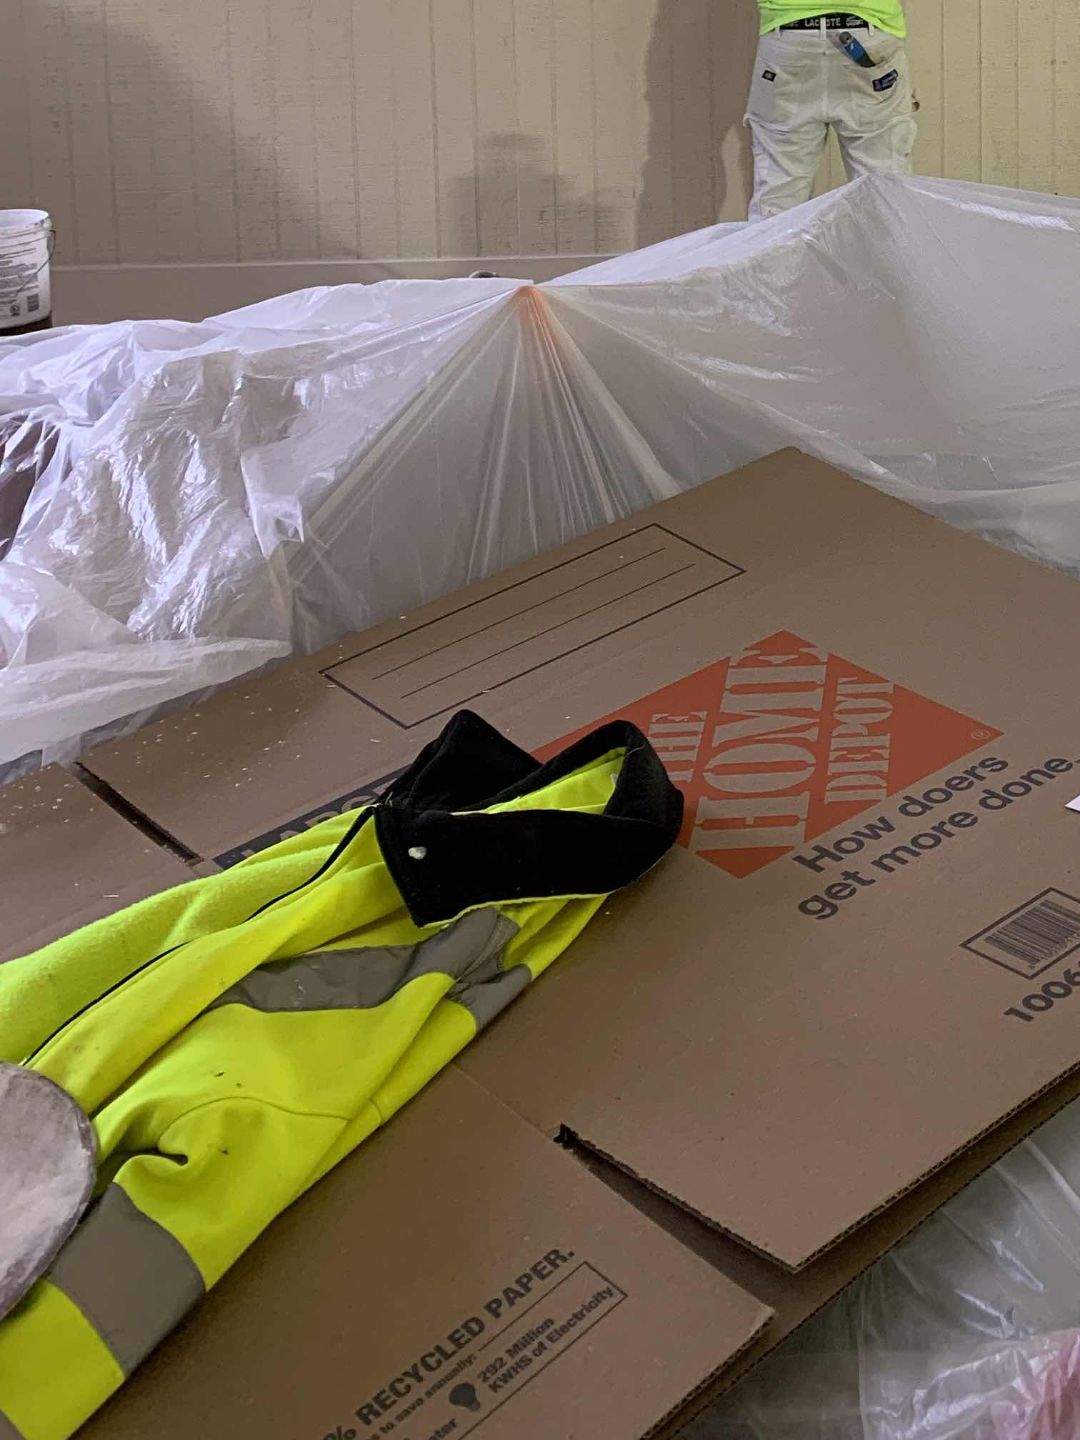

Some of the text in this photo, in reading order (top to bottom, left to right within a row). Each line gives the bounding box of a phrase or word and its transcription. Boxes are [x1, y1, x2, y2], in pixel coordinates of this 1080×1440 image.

[804, 17, 841, 27] LACSTE
[687, 647, 828, 853] HOME
[824, 676, 895, 805] DEPOT
[792, 756, 1009, 873] How doers
[798, 870, 876, 920] get
[870, 811, 978, 873] more
[354, 1249, 575, 1426] RECYCLED PAPER.
[477, 1318, 554, 1383] 292 Million
[488, 1286, 614, 1394] KWHS of Electricity
